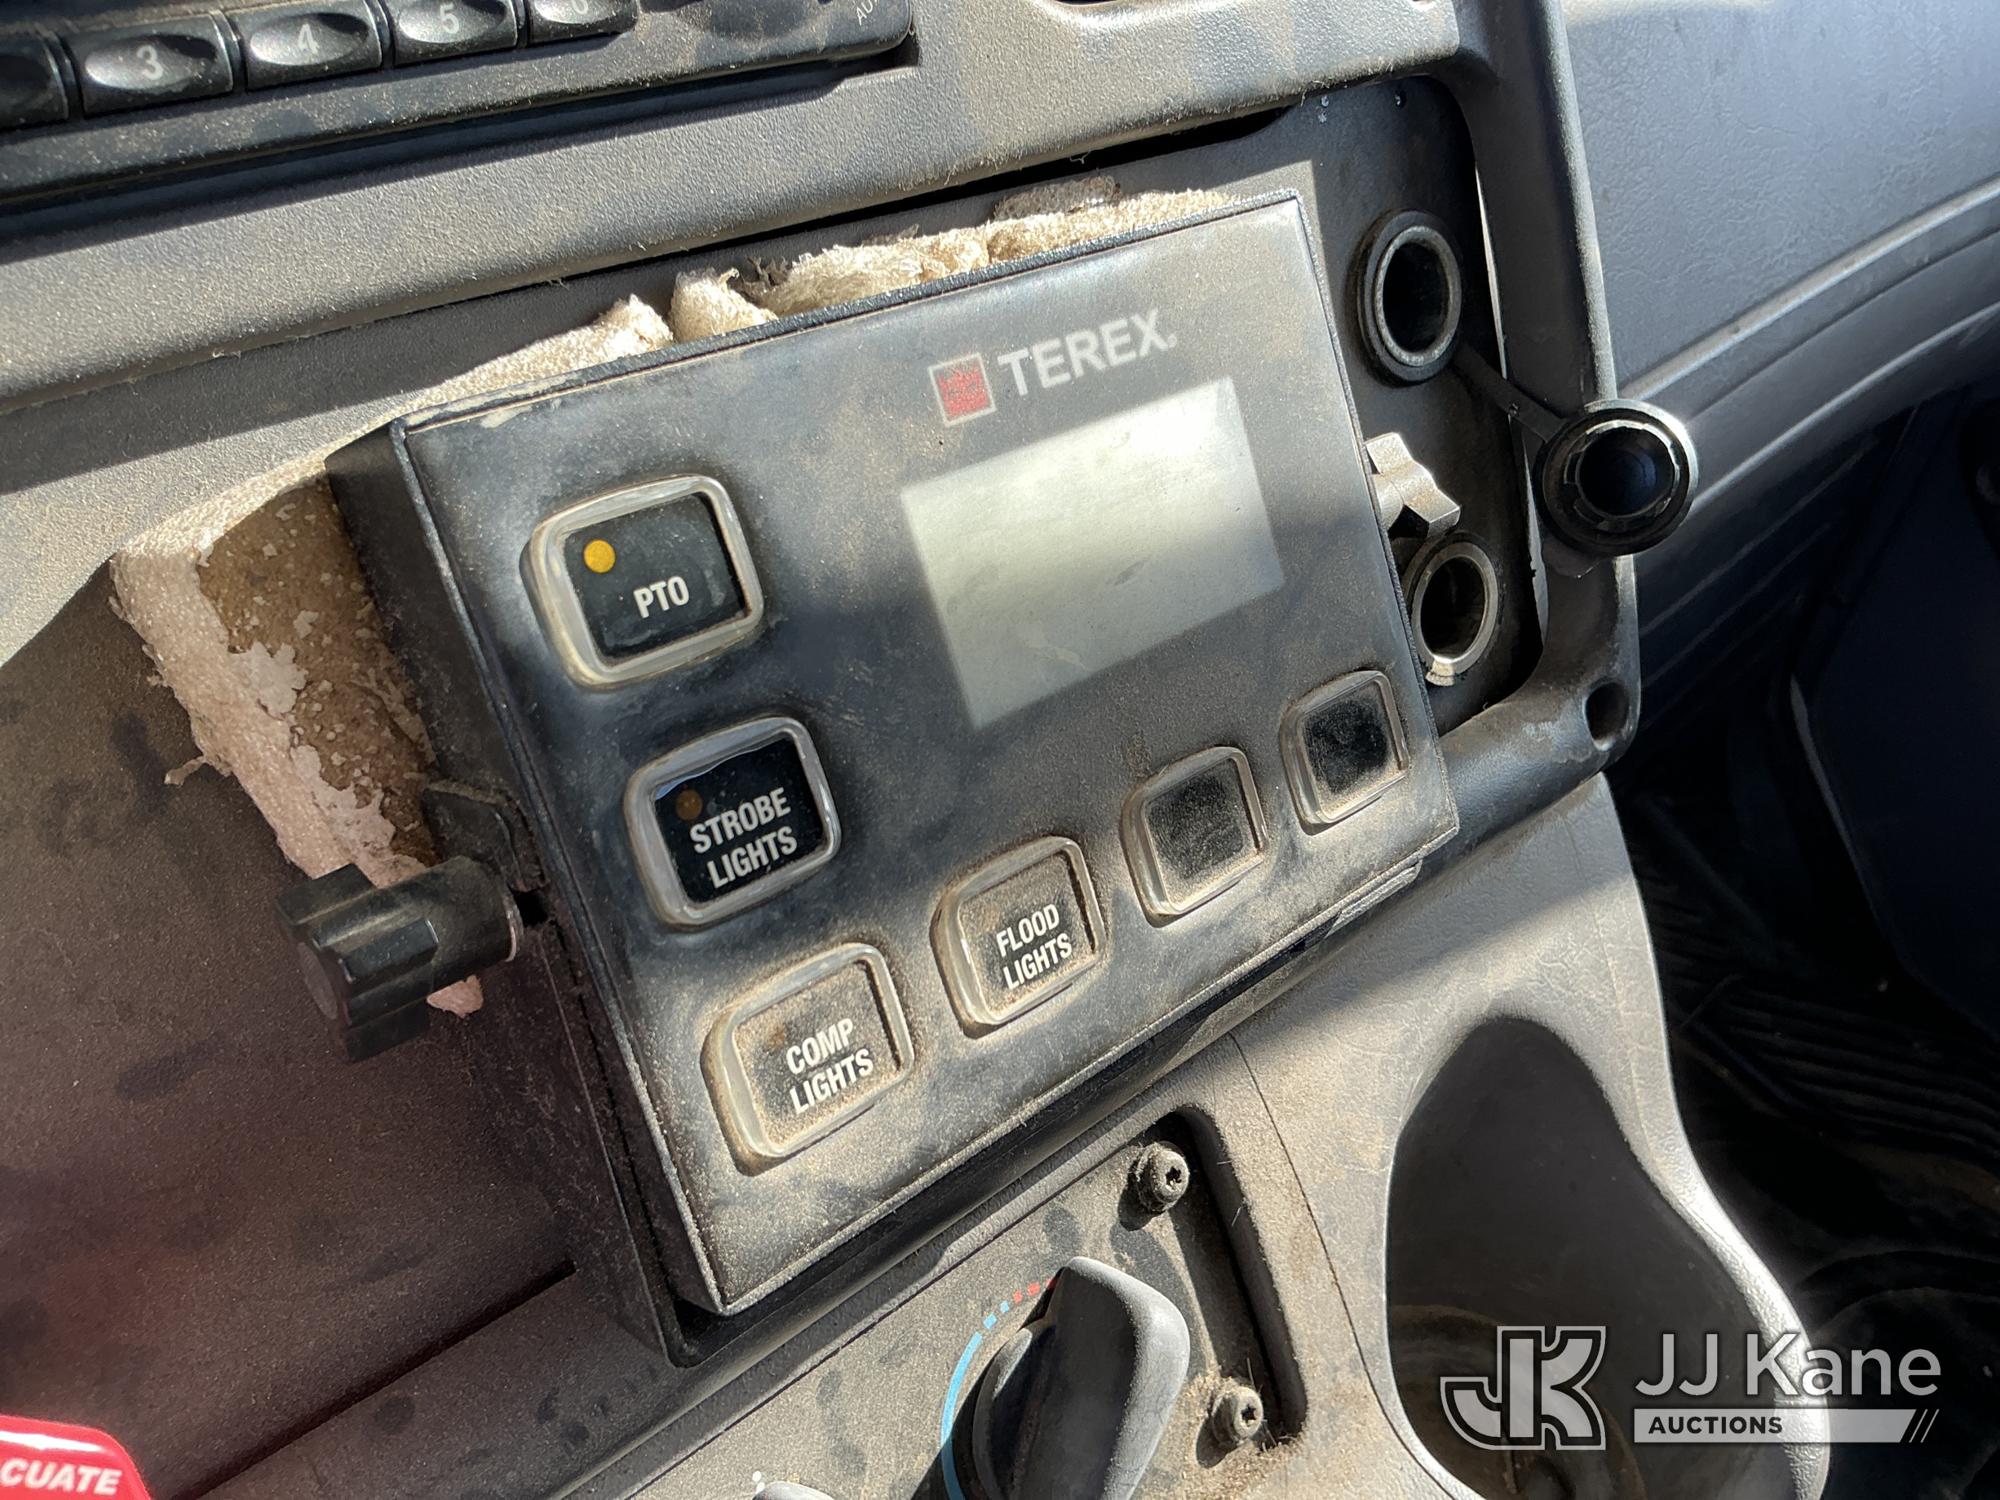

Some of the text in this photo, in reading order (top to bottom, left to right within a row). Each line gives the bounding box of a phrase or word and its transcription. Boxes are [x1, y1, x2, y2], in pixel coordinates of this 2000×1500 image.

[299, 23, 319, 55] 4
[439, 2, 460, 34] 5
[136, 44, 164, 80] 3
[997, 309, 1169, 396] TEREX
[633, 576, 690, 618] PTO
[689, 787, 791, 855] STROBE
[706, 826, 798, 888] LIGHTS
[996, 904, 1060, 957] FLOOD
[1002, 933, 1073, 990] LIGHTS
[785, 1018, 855, 1076] COMP
[789, 1048, 874, 1115] LIGHTS
[0, 1457, 123, 1496] CUATE
